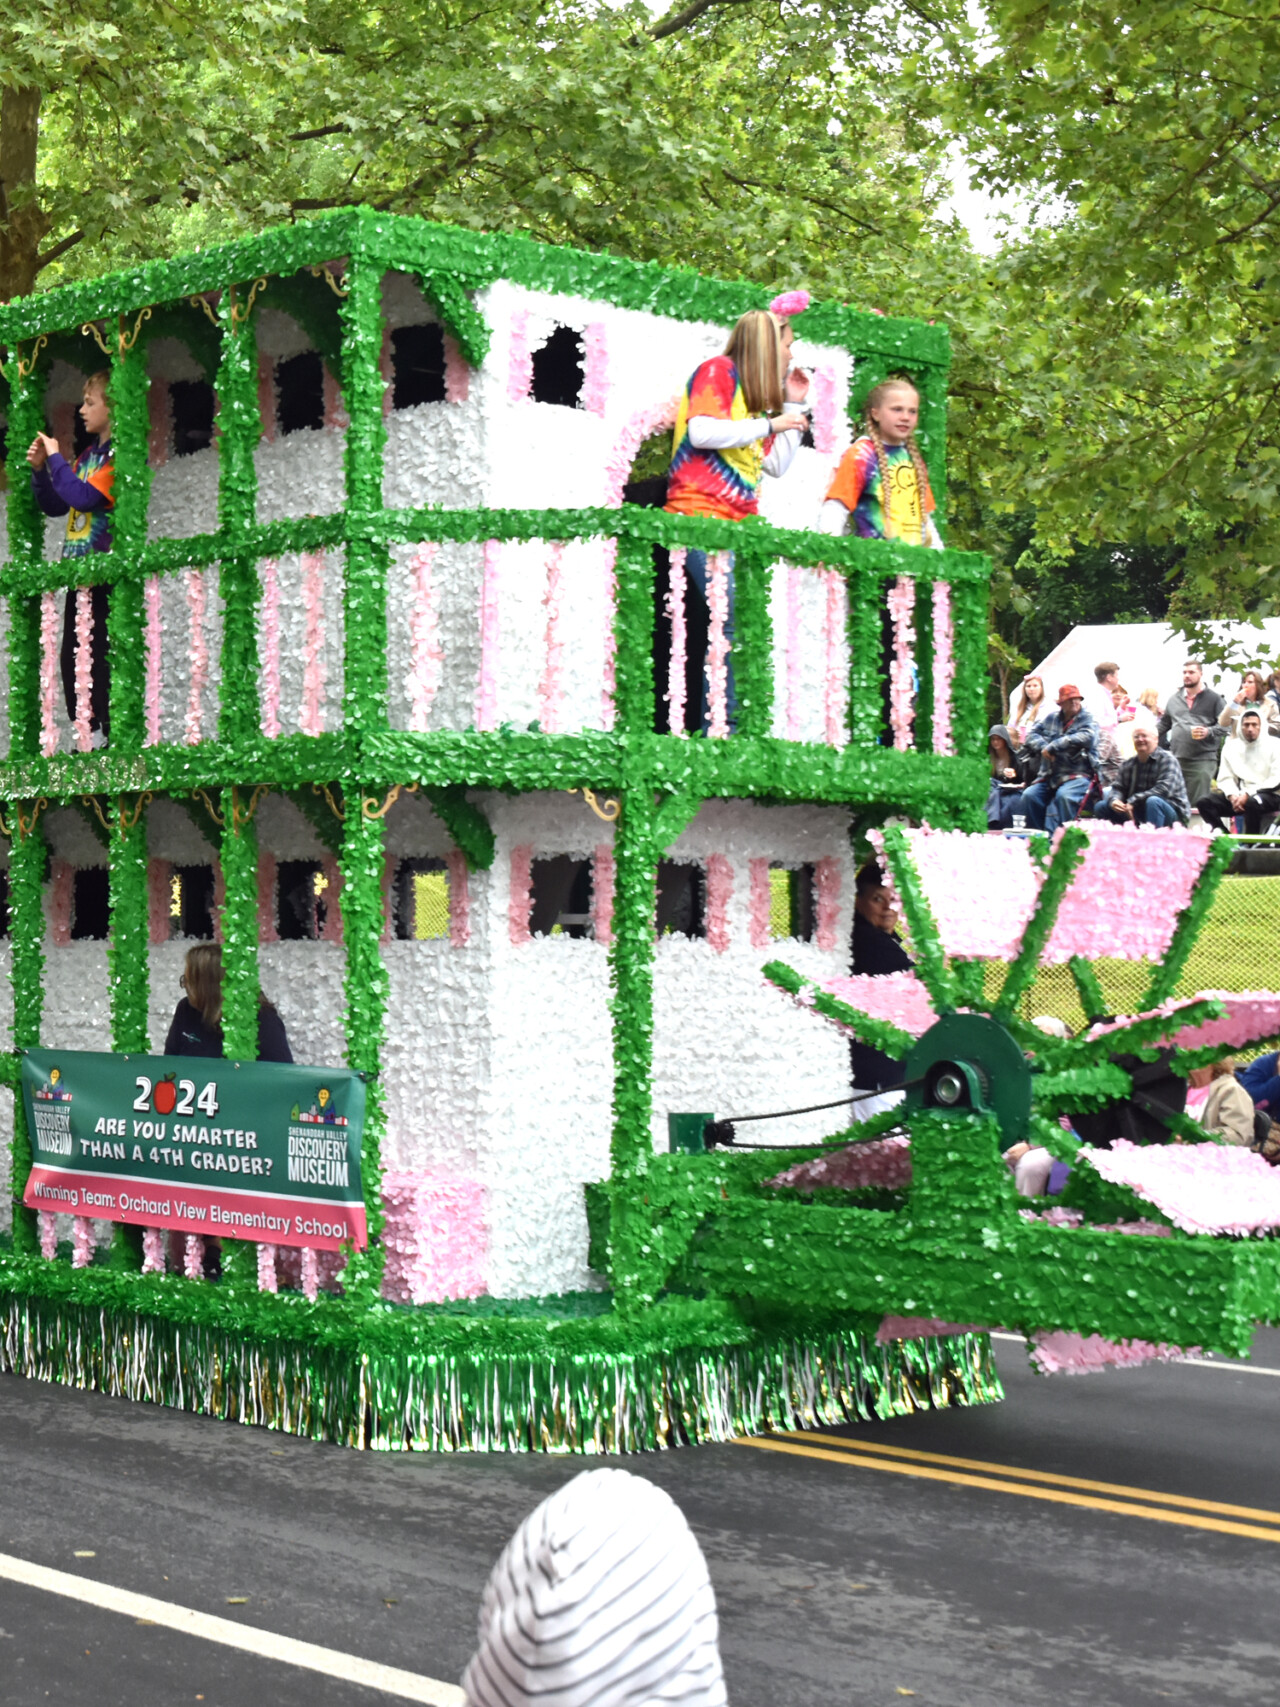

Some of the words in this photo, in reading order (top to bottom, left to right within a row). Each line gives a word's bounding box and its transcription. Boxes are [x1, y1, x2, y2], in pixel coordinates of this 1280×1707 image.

[36, 1129, 72, 1156] MUSEUM
[94, 1117, 127, 1137] ARE
[132, 1120, 167, 1141] YOU
[172, 1124, 258, 1150] SMARTER
[288, 1126, 325, 1139] SHENANDOAH
[325, 1130, 348, 1141] VALLEY
[288, 1136, 348, 1161] DISCOVERY
[80, 1138, 127, 1161] THAN
[132, 1144, 145, 1163] A
[149, 1146, 185, 1167] 4TH
[190, 1150, 274, 1177] GRADER?
[288, 1156, 350, 1188] MUSEUM
[34, 1181, 79, 1206] Winning
[80, 1187, 117, 1209] Team:
[119, 1192, 171, 1217] Orchard
[173, 1200, 207, 1220] View
[210, 1205, 291, 1236] Elementary
[295, 1215, 349, 1239] School
